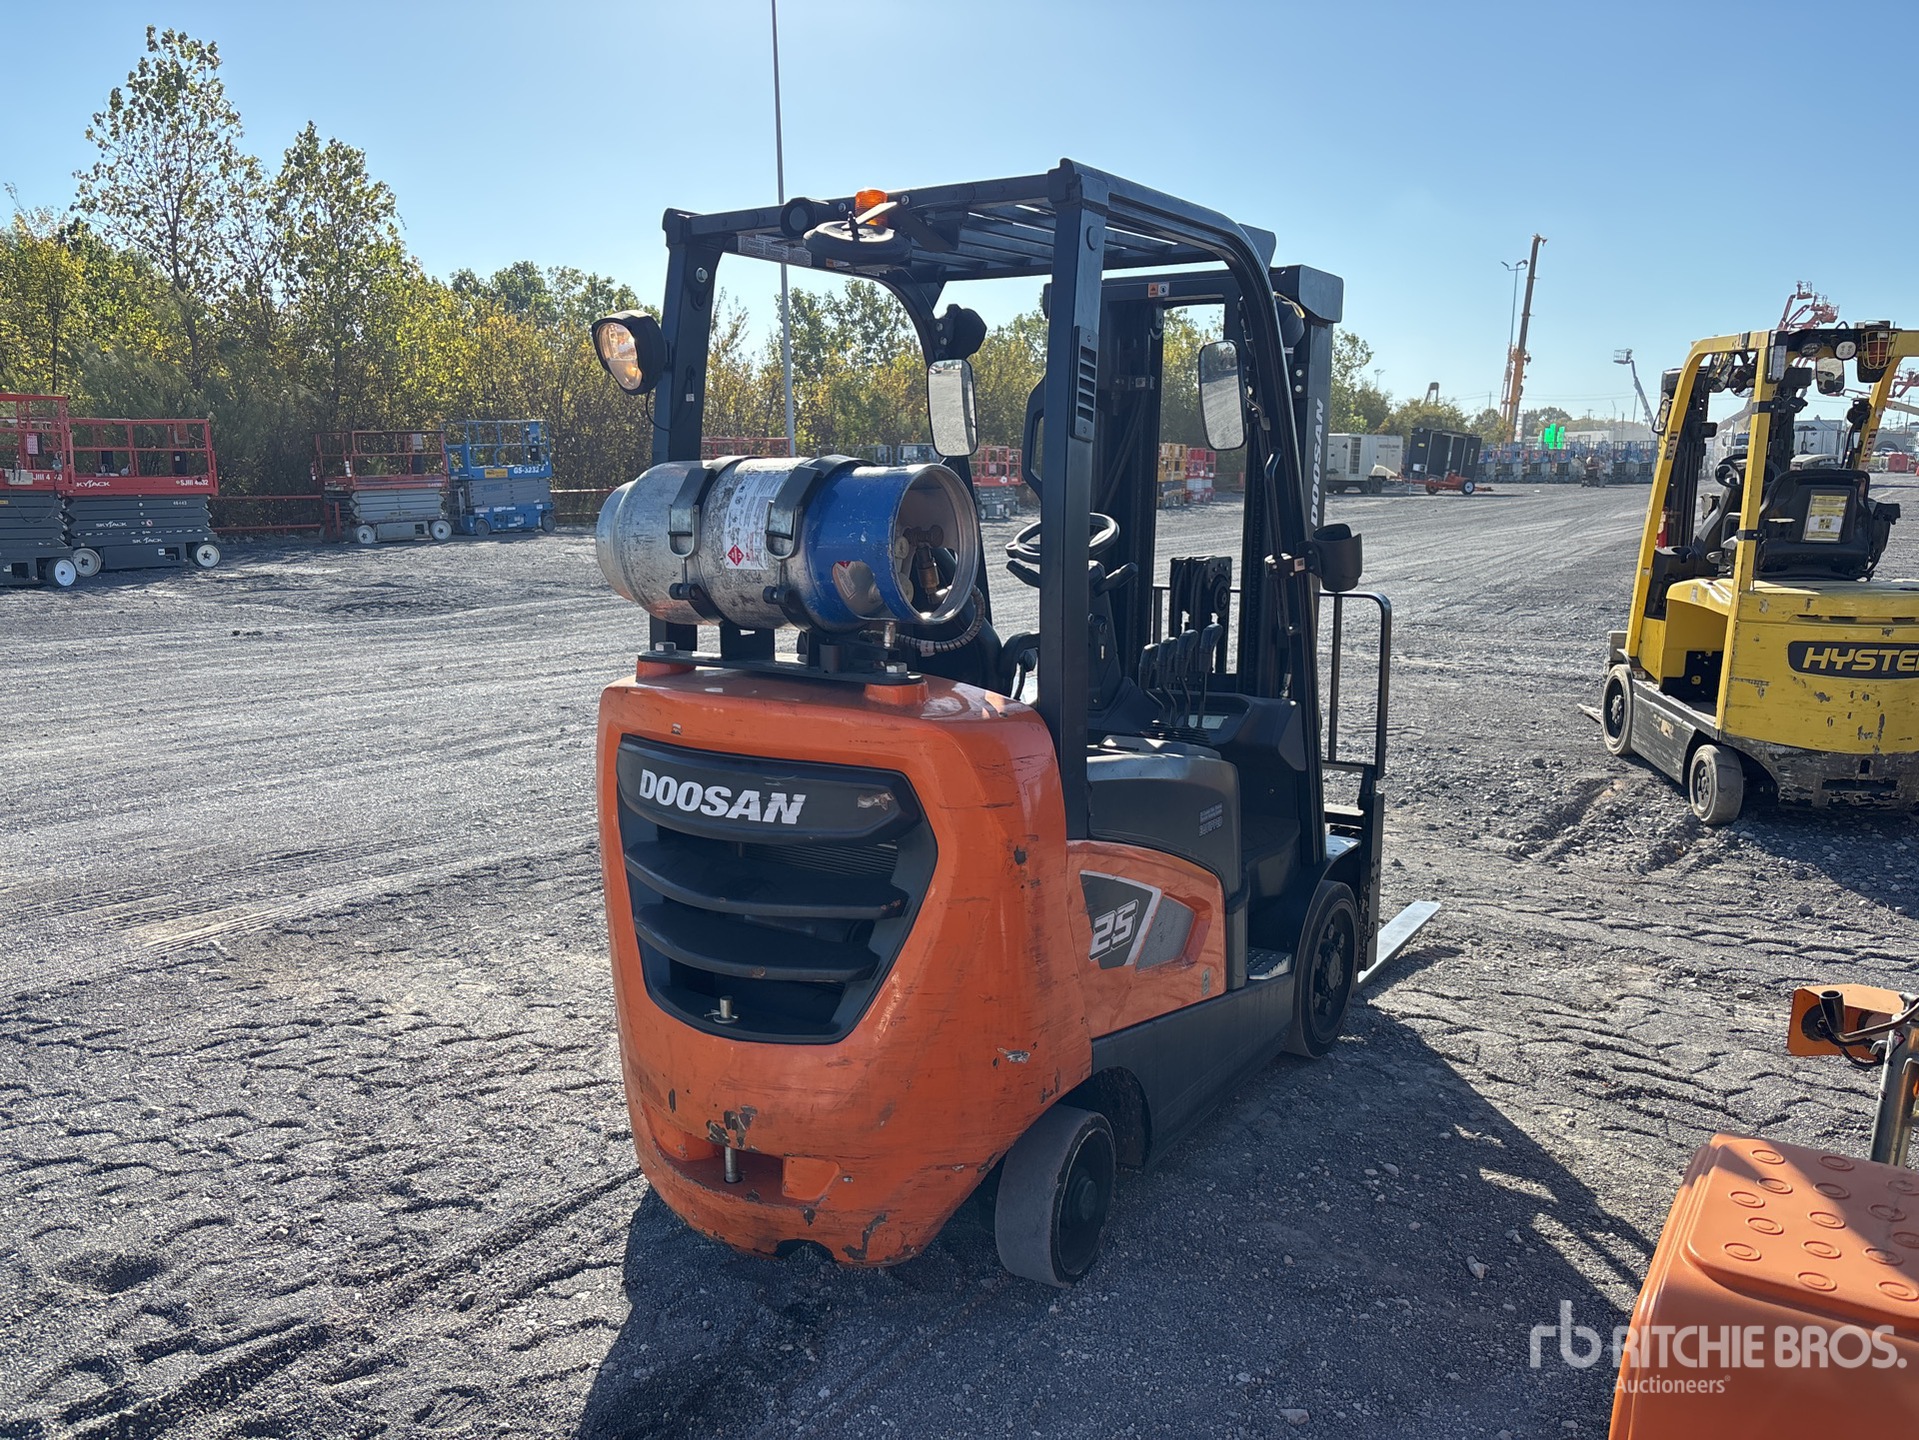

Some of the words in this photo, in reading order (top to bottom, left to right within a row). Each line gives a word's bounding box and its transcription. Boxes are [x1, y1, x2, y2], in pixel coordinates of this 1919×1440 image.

[1310, 398, 1324, 527] DOOSAN
[76, 479, 111, 489] KYJACK
[96, 520, 127, 528] SKYJACK
[1802, 647, 1919, 671] HYSTE
[639, 769, 806, 825] DOOSAN
[1089, 899, 1139, 961] 25
